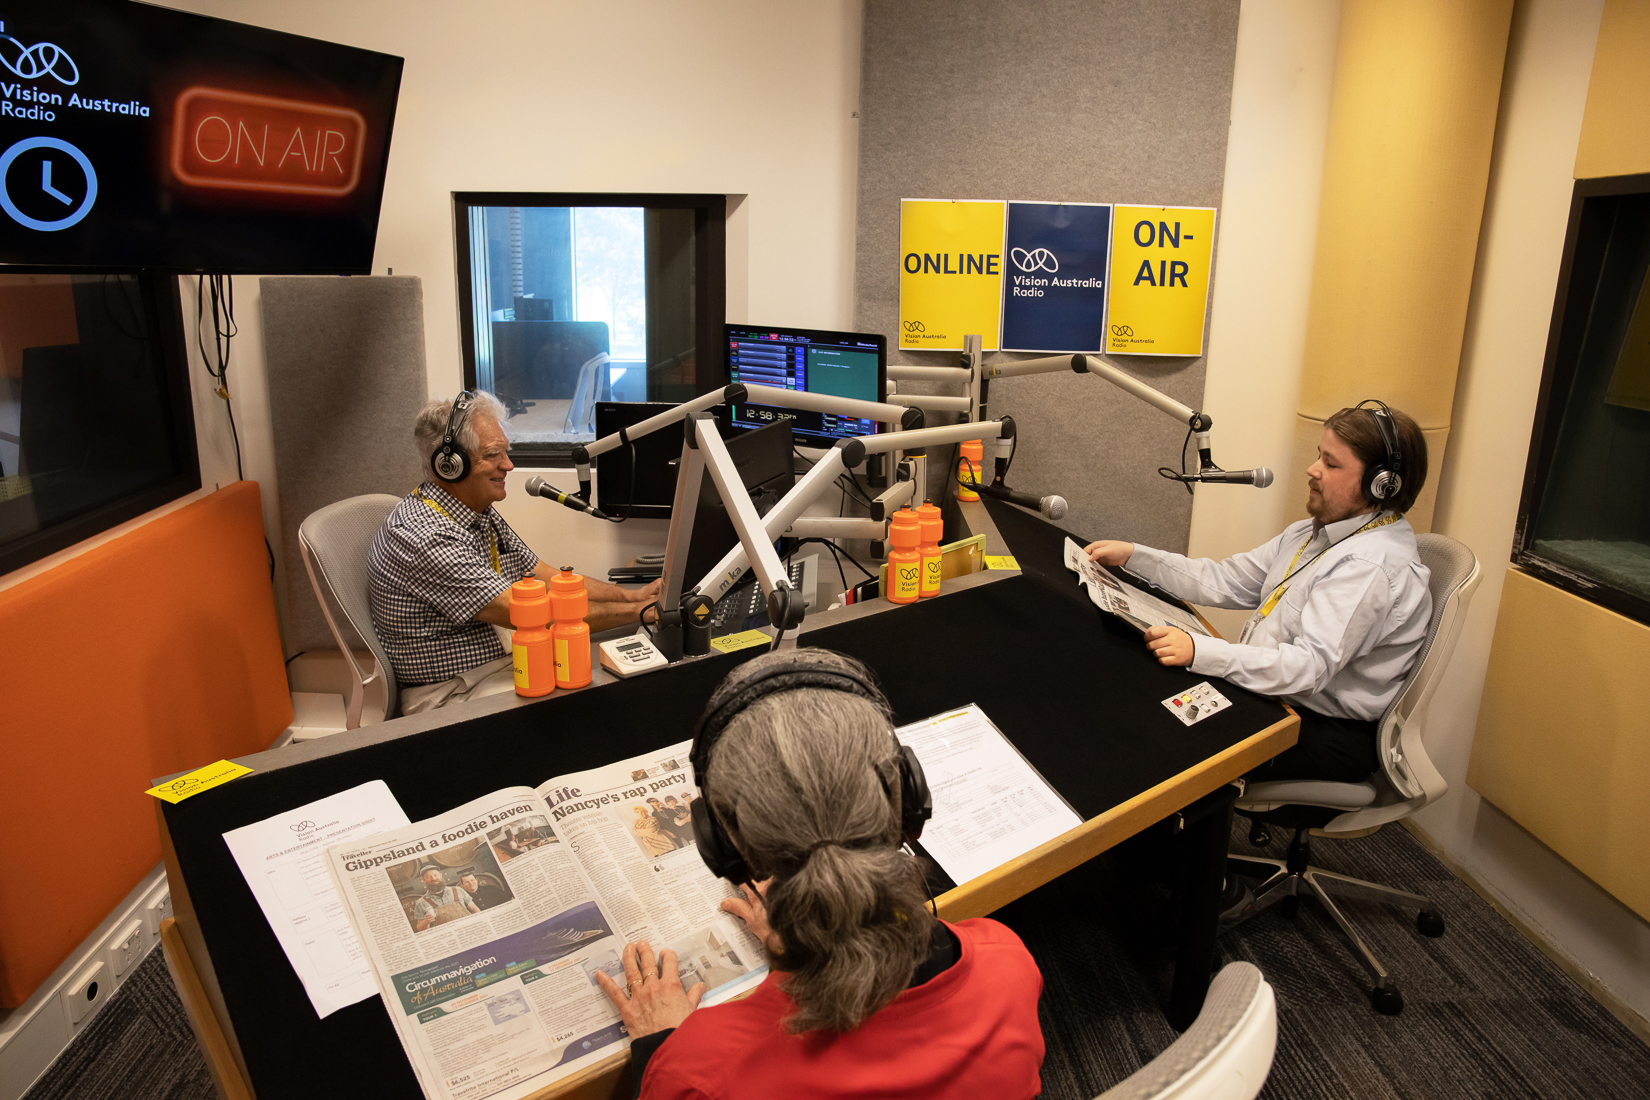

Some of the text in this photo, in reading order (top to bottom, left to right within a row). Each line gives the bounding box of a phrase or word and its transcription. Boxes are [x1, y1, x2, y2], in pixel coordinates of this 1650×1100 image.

[0, 82, 150, 117] Vision Australia
[1, 102, 55, 122] Radio
[195, 115, 346, 174] ON AIR
[1133, 219, 1194, 249] ON-
[904, 252, 1000, 275] ONLINE
[1132, 259, 1189, 288] AIR
[1013, 275, 1102, 289] Vision Australia
[1013, 286, 1044, 298] Radio
[544, 786, 583, 810] Life
[552, 772, 687, 822] Nancye's rap party
[296, 820, 340, 838] Vision Australia
[344, 841, 427, 872] Gippsland
[429, 838, 440, 848] a
[441, 818, 488, 844] foodie
[488, 804, 534, 825] haven
[341, 850, 372, 861] Traveller
[406, 956, 497, 993] Circumnavigation
[410, 991, 423, 1005] of
[422, 976, 474, 1001] Australia
